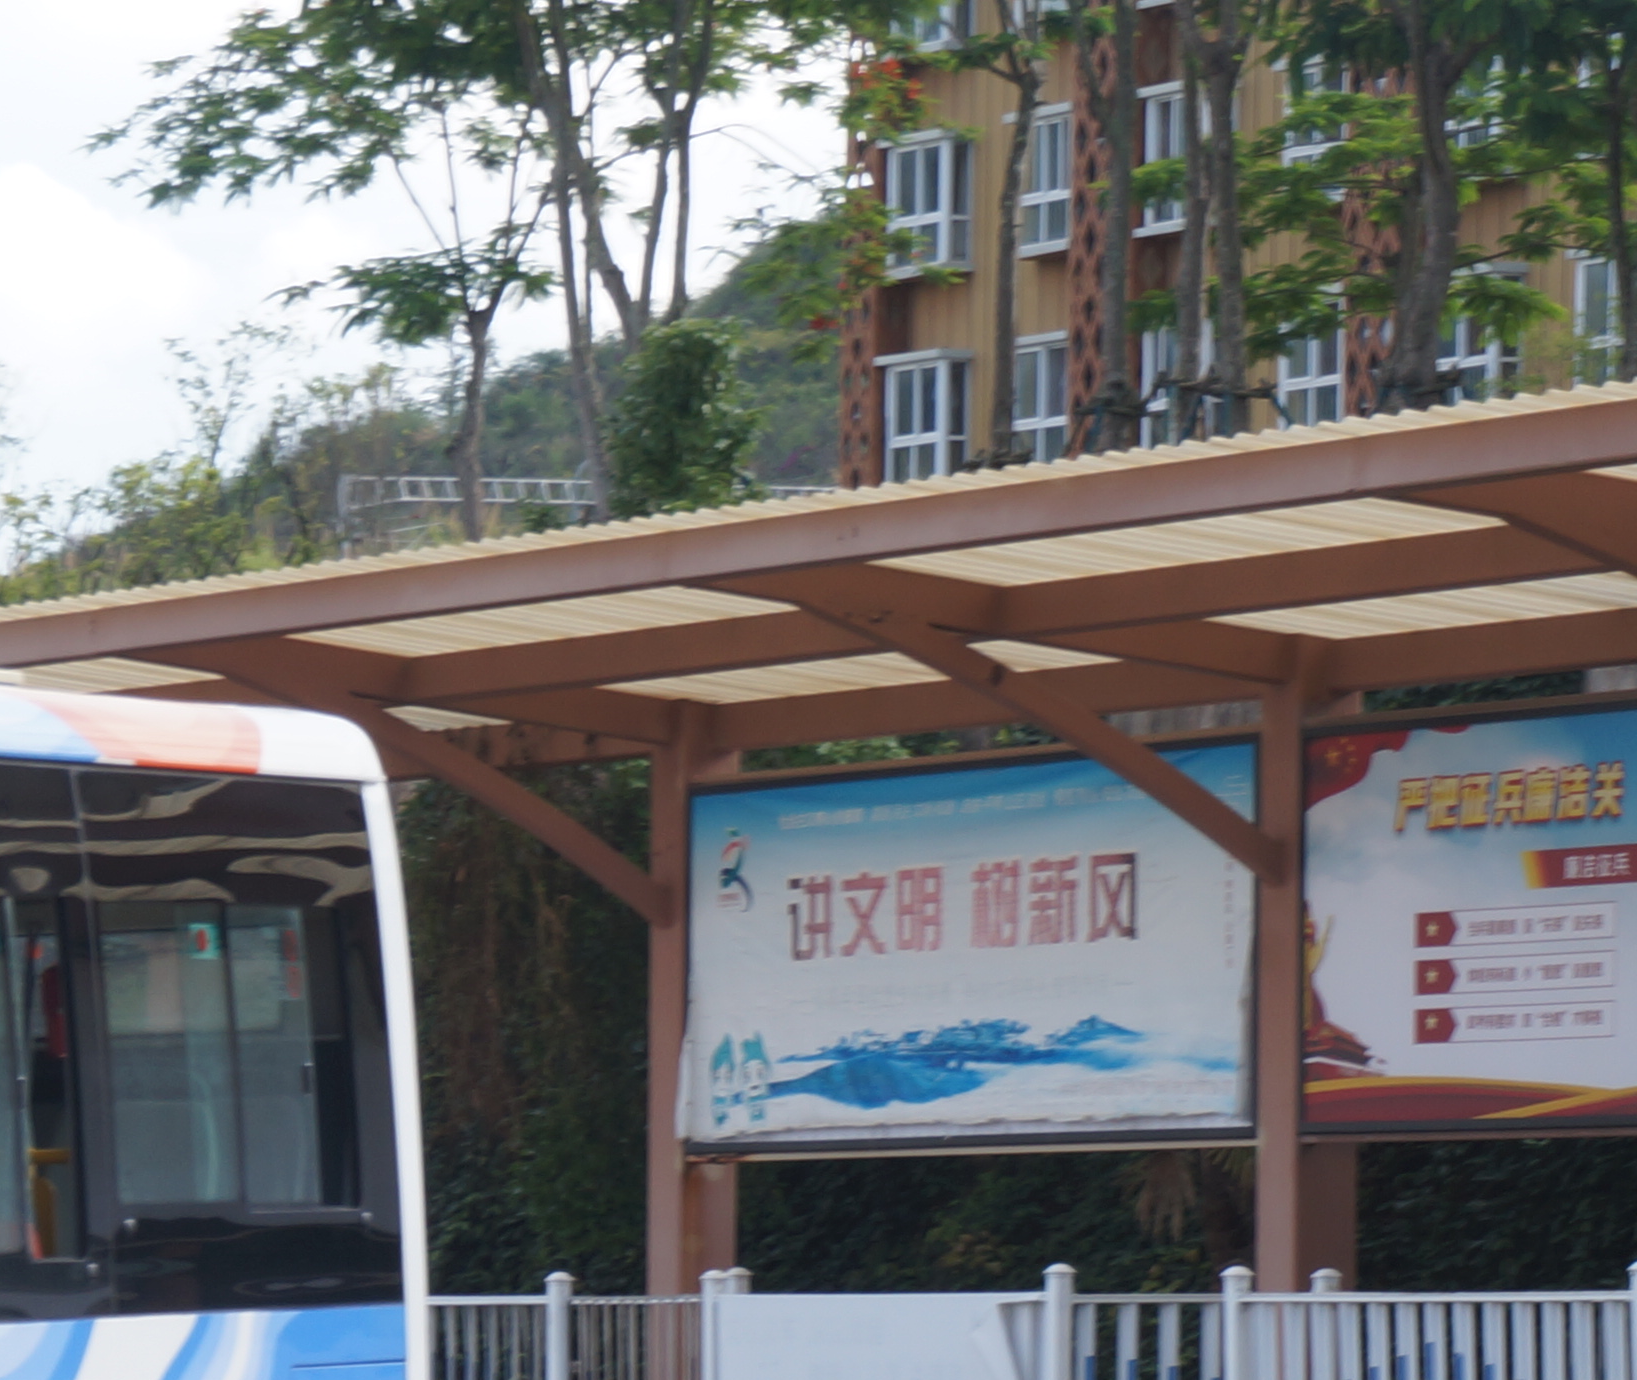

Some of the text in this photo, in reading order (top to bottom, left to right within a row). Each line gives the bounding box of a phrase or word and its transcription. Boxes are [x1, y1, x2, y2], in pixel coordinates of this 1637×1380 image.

[1393, 760, 1625, 832] 严把征兵廉洁关
[787, 866, 945, 962] 讲文明
[969, 852, 1138, 948] 树新风
